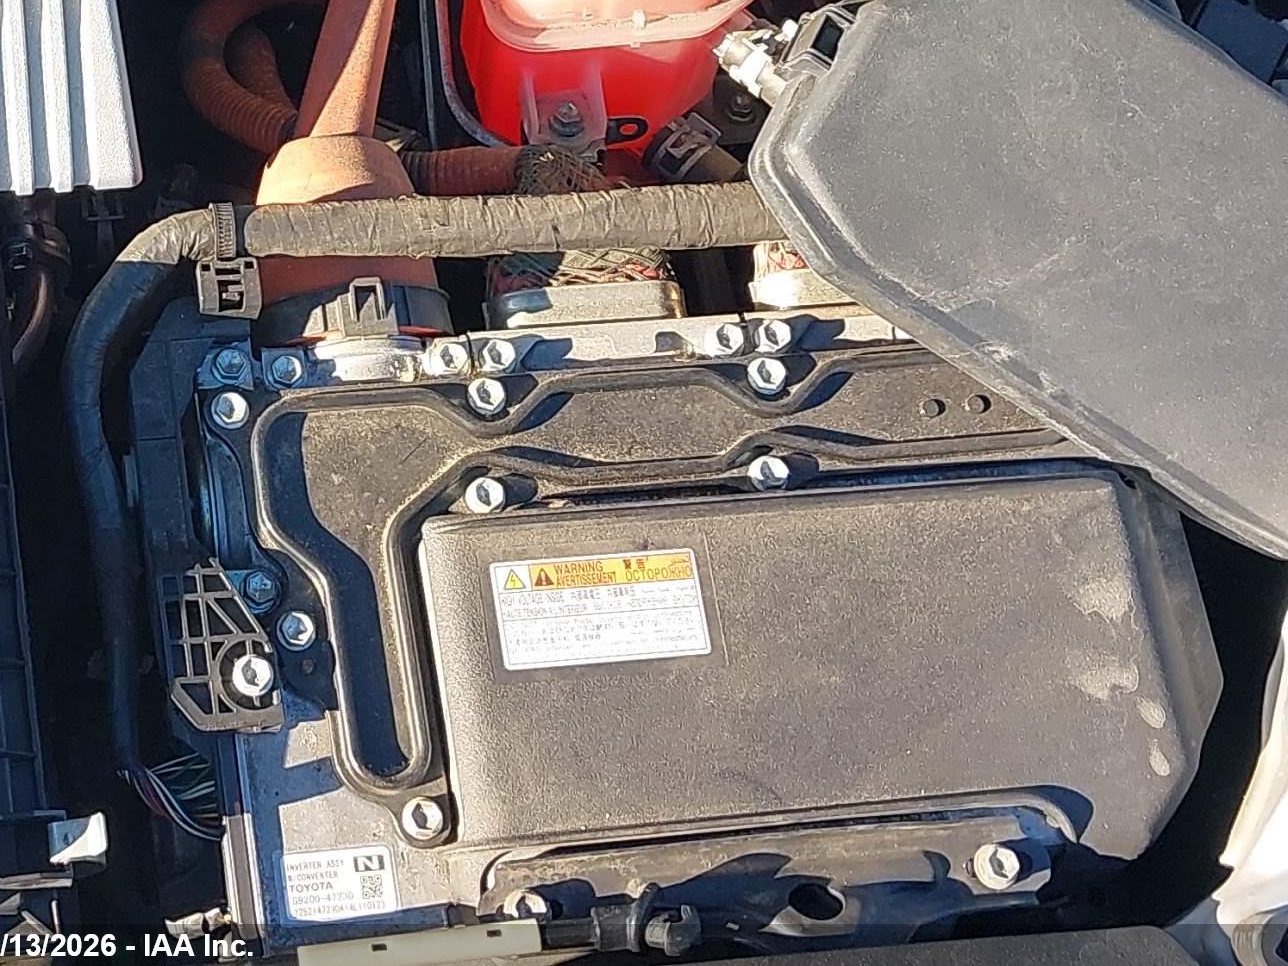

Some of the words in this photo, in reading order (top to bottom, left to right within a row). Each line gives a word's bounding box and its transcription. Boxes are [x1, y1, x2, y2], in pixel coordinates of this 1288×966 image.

[554, 560, 603, 575] WARNING
[556, 571, 617, 587] AVERTISSEMENT
[286, 860, 322, 872] INVERTER
[326, 859, 345, 868] ASSY
[289, 881, 334, 894] TOYOTA
